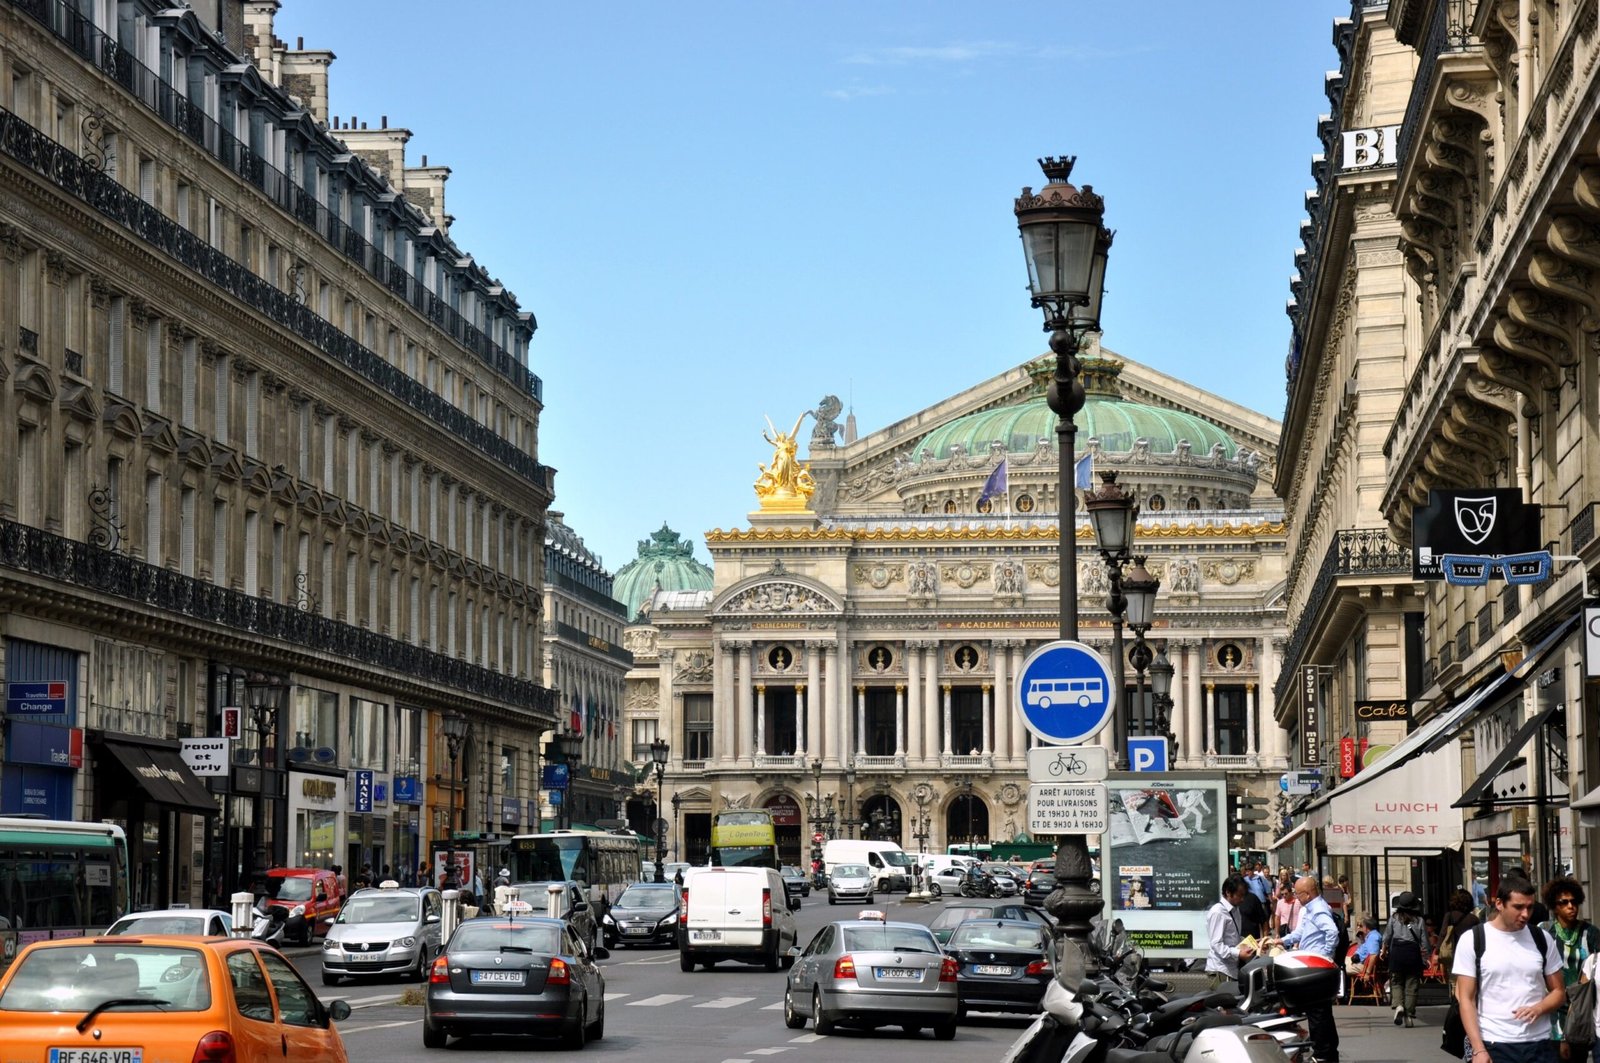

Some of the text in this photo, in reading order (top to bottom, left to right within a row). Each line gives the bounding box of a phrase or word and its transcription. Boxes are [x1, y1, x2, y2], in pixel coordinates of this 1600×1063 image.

[20, 703, 53, 711] Change
[1358, 703, 1408, 717] Café
[1134, 748, 1155, 772] P
[1344, 741, 1352, 774] bodum
[360, 773, 369, 811] CHANGE
[1040, 788, 1096, 796] ARRÊT AUTORISÉ
[1375, 803, 1438, 812] LUNCH
[1037, 810, 1046, 818] DE
[1048, 810, 1070, 818] 19H30
[1080, 810, 1098, 818] 7H30
[1332, 824, 1438, 834] BREAKFAST
